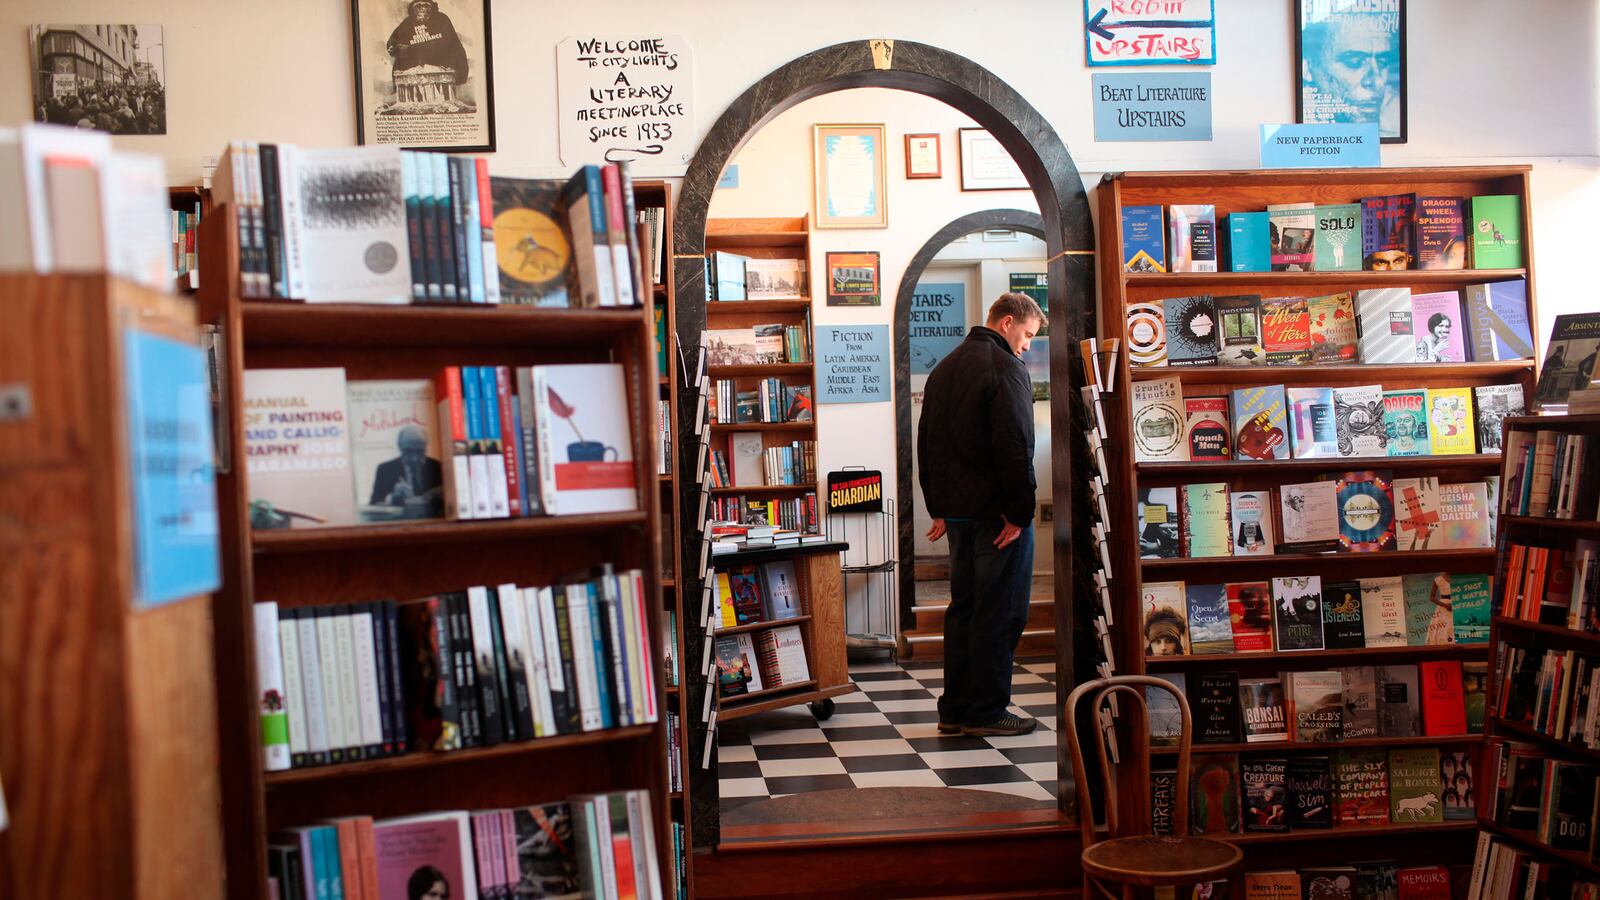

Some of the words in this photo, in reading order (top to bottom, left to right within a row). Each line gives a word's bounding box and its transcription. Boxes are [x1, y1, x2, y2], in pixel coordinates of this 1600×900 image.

[577, 38, 668, 55] WELCOME
[1096, 33, 1203, 60] UPSTAIRS
[602, 57, 630, 68] CITY
[632, 54, 678, 71] LIGHTS
[614, 71, 631, 86] A
[590, 84, 673, 104] LITERARY
[577, 103, 684, 121] MEETINGPLACE
[589, 126, 628, 143] SINCE
[637, 123, 673, 141] 1953
[1277, 137, 1300, 145] NEW
[1303, 136, 1363, 145] PAPERBACK
[1300, 147, 1340, 155] FICTION
[1367, 199, 1384, 208] NO
[1376, 210, 1405, 219] STAR
[1320, 216, 1355, 231] SOLO
[1419, 217, 1462, 225] SPLENDOR
[1263, 308, 1302, 326] West
[1475, 291, 1491, 357] Unigwe
[1267, 328, 1277, 337] of
[1280, 325, 1307, 342] Here
[1135, 382, 1175, 393] Grunt's
[1135, 389, 1176, 400] Minutia
[1383, 395, 1422, 413] DRUGS
[268, 411, 343, 423] PAINTING
[1193, 434, 1224, 443] Jonah
[1199, 442, 1220, 450] Man
[849, 477, 872, 487] FRANCISCO
[1440, 485, 1465, 494] BABY
[831, 483, 881, 508] GUARDIAN
[1440, 493, 1475, 502] GEISHA
[1440, 504, 1473, 512] TRINIE
[1441, 511, 1478, 521] DALTON
[1464, 582, 1482, 590] SHOT
[1463, 591, 1488, 599] WATER
[1191, 604, 1212, 615] Open
[1194, 614, 1219, 623] Secret
[1415, 611, 1441, 624] Silver
[1409, 621, 1447, 638] Sparrow
[1201, 680, 1214, 688] The
[1200, 697, 1232, 705] Werewolf
[1246, 705, 1284, 723] BONSAI
[1298, 711, 1341, 722] CALEB'S
[1299, 721, 1340, 729] CROSSING
[1265, 763, 1284, 772] GREAT
[1341, 763, 1360, 771] THE
[1363, 761, 1385, 770] SLY
[1243, 772, 1284, 783] CREATURE
[1340, 771, 1385, 782] COMPANY
[1353, 782, 1386, 790] PEOPLE
[1406, 778, 1438, 787] BONES
[1363, 790, 1387, 798] CARE
[1152, 776, 1171, 835] THREATS
[1298, 794, 1325, 808] Sim
[1560, 821, 1586, 837] DOG
[1402, 873, 1446, 884] MEMOIRS
